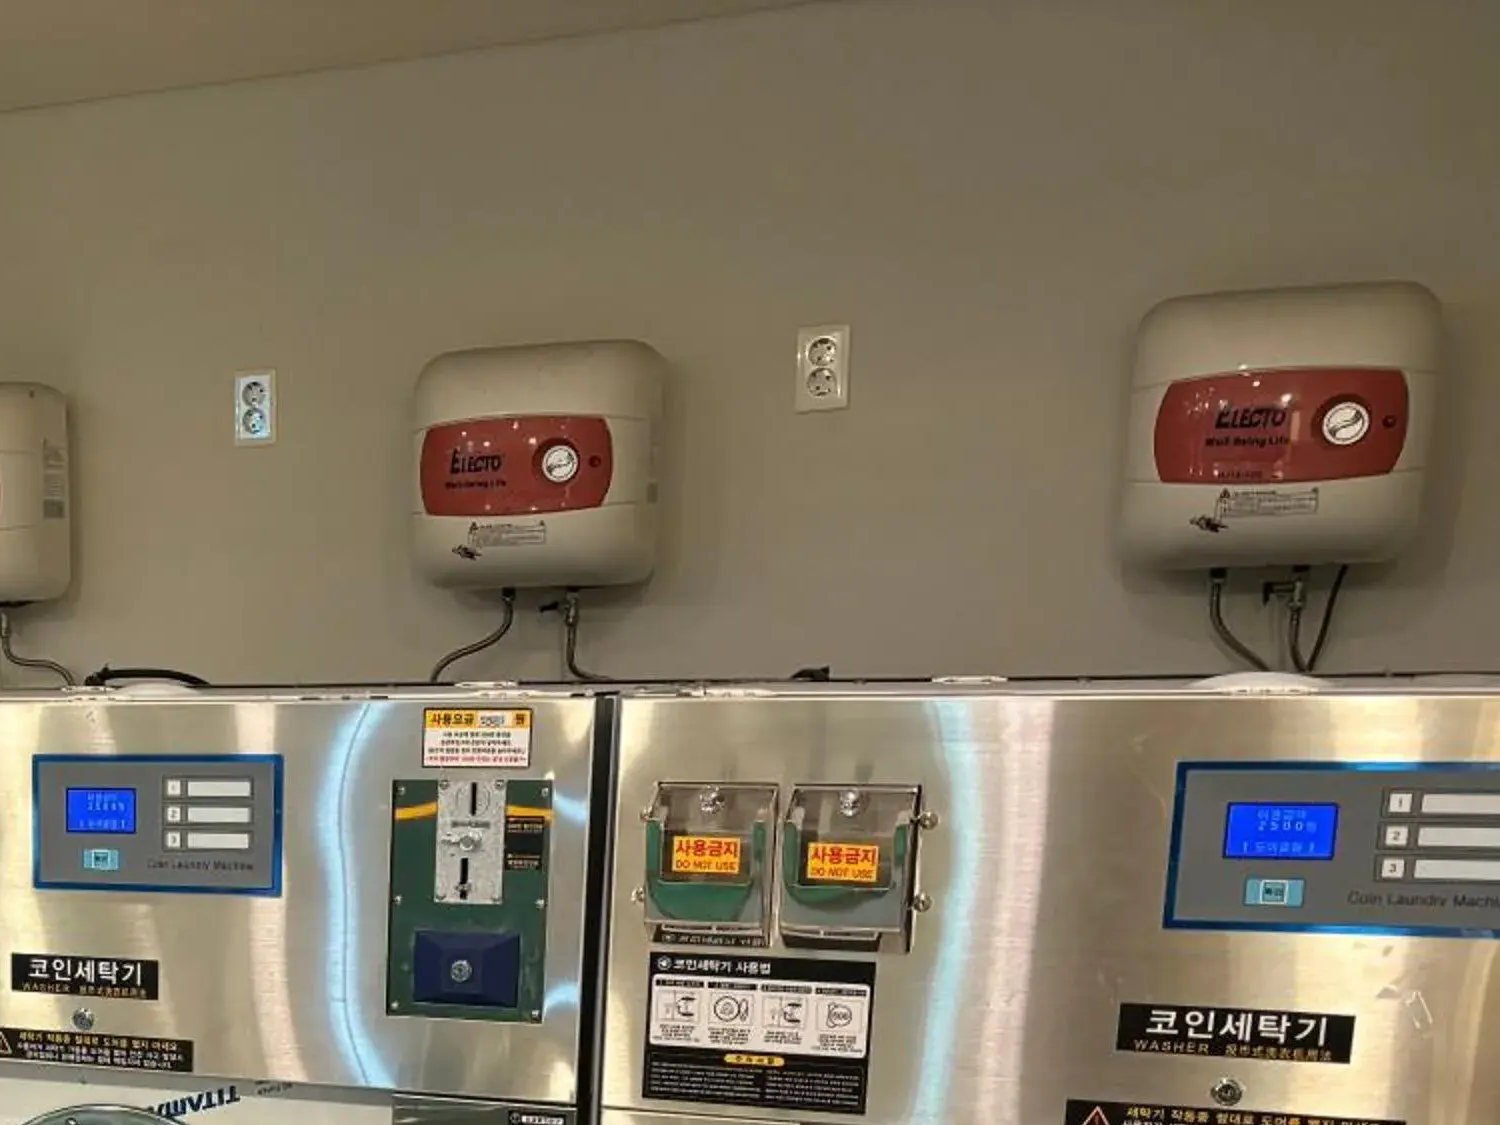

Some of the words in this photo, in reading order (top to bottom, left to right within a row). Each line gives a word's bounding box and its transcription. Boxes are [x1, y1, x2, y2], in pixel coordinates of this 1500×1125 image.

[1215, 404, 1286, 429] ELECTO
[1233, 436, 1266, 448] Being
[450, 449, 505, 474] ELECTO
[1392, 830, 1401, 842] 2
[676, 838, 738, 857] 사용금지
[811, 847, 877, 865] 사용금지
[693, 860, 712, 870] NOT
[715, 861, 736, 871] USE
[828, 868, 848, 877] NOT
[851, 869, 873, 879] USE
[1388, 863, 1397, 874] 3
[1347, 890, 1382, 905] Coin
[1387, 892, 1448, 909] Laundry
[28, 957, 141, 986] 코인세탁기
[673, 958, 731, 974] 코인세탁기
[736, 960, 771, 975] 사용법
[1145, 1009, 1328, 1047] 코인세탁기
[1133, 1039, 1210, 1055] WASHER
[1127, 1107, 1165, 1120] 세탁기
[1170, 1109, 1209, 1123] 작동중
[1216, 1112, 1253, 1125] 절대로
